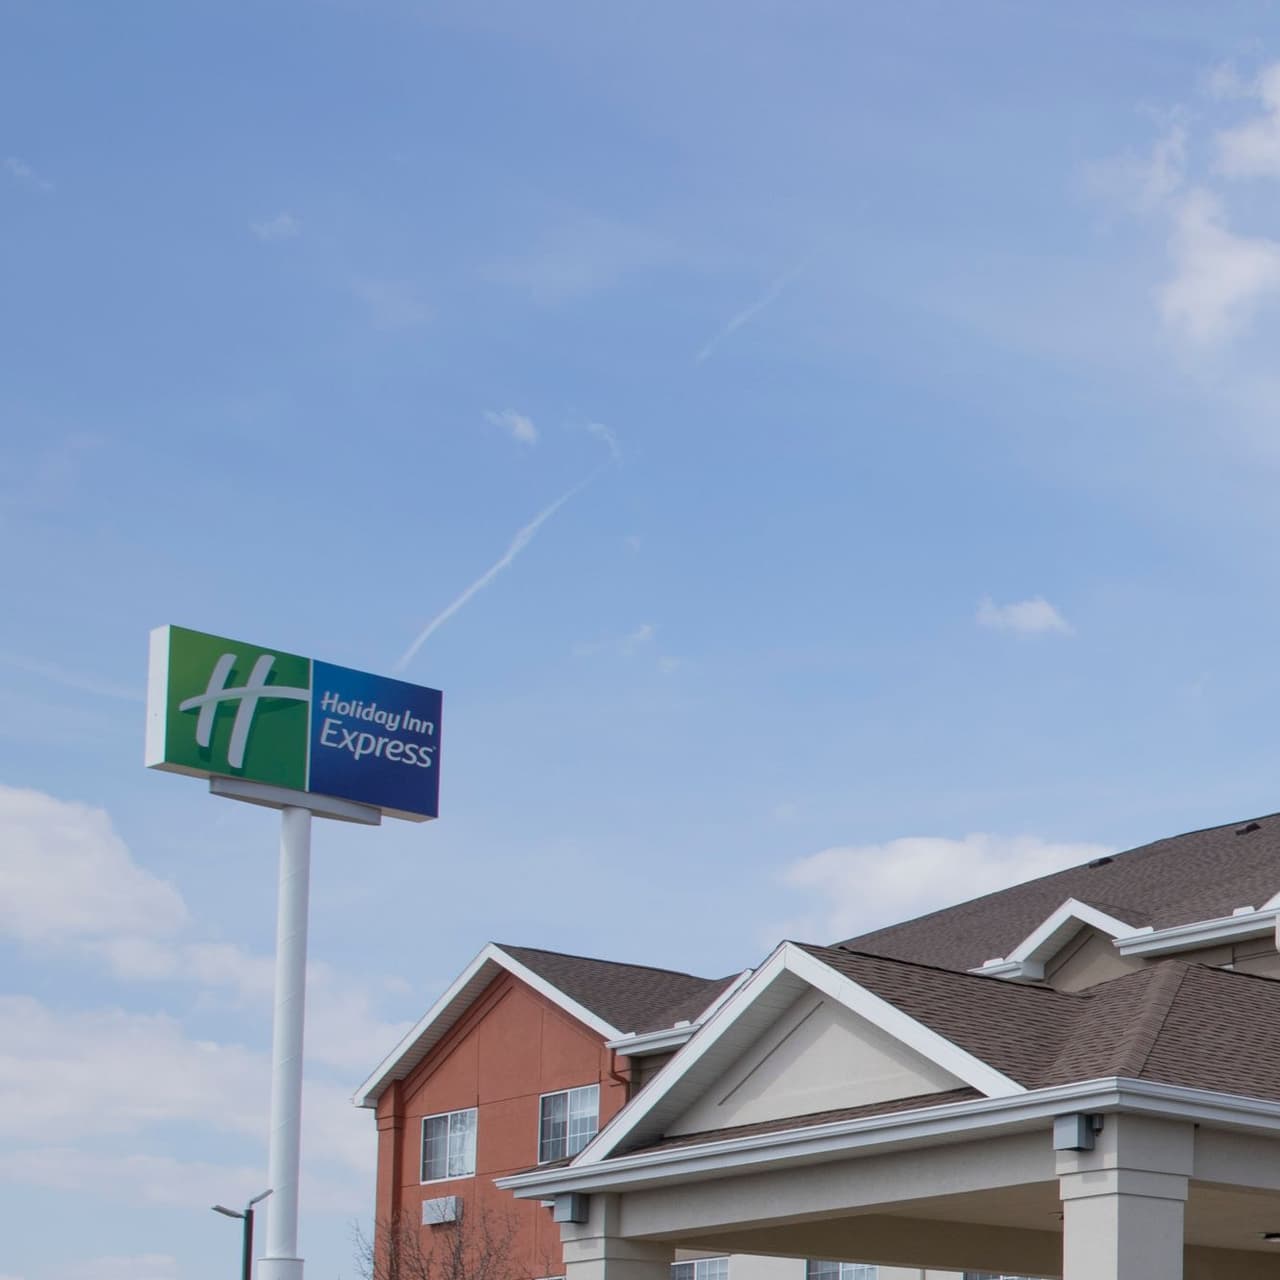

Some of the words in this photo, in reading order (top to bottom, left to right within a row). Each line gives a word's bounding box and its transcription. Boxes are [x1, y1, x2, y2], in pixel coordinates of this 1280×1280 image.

[321, 691, 400, 731] Holiday
[402, 710, 434, 735] Inn
[320, 717, 433, 767] Express
